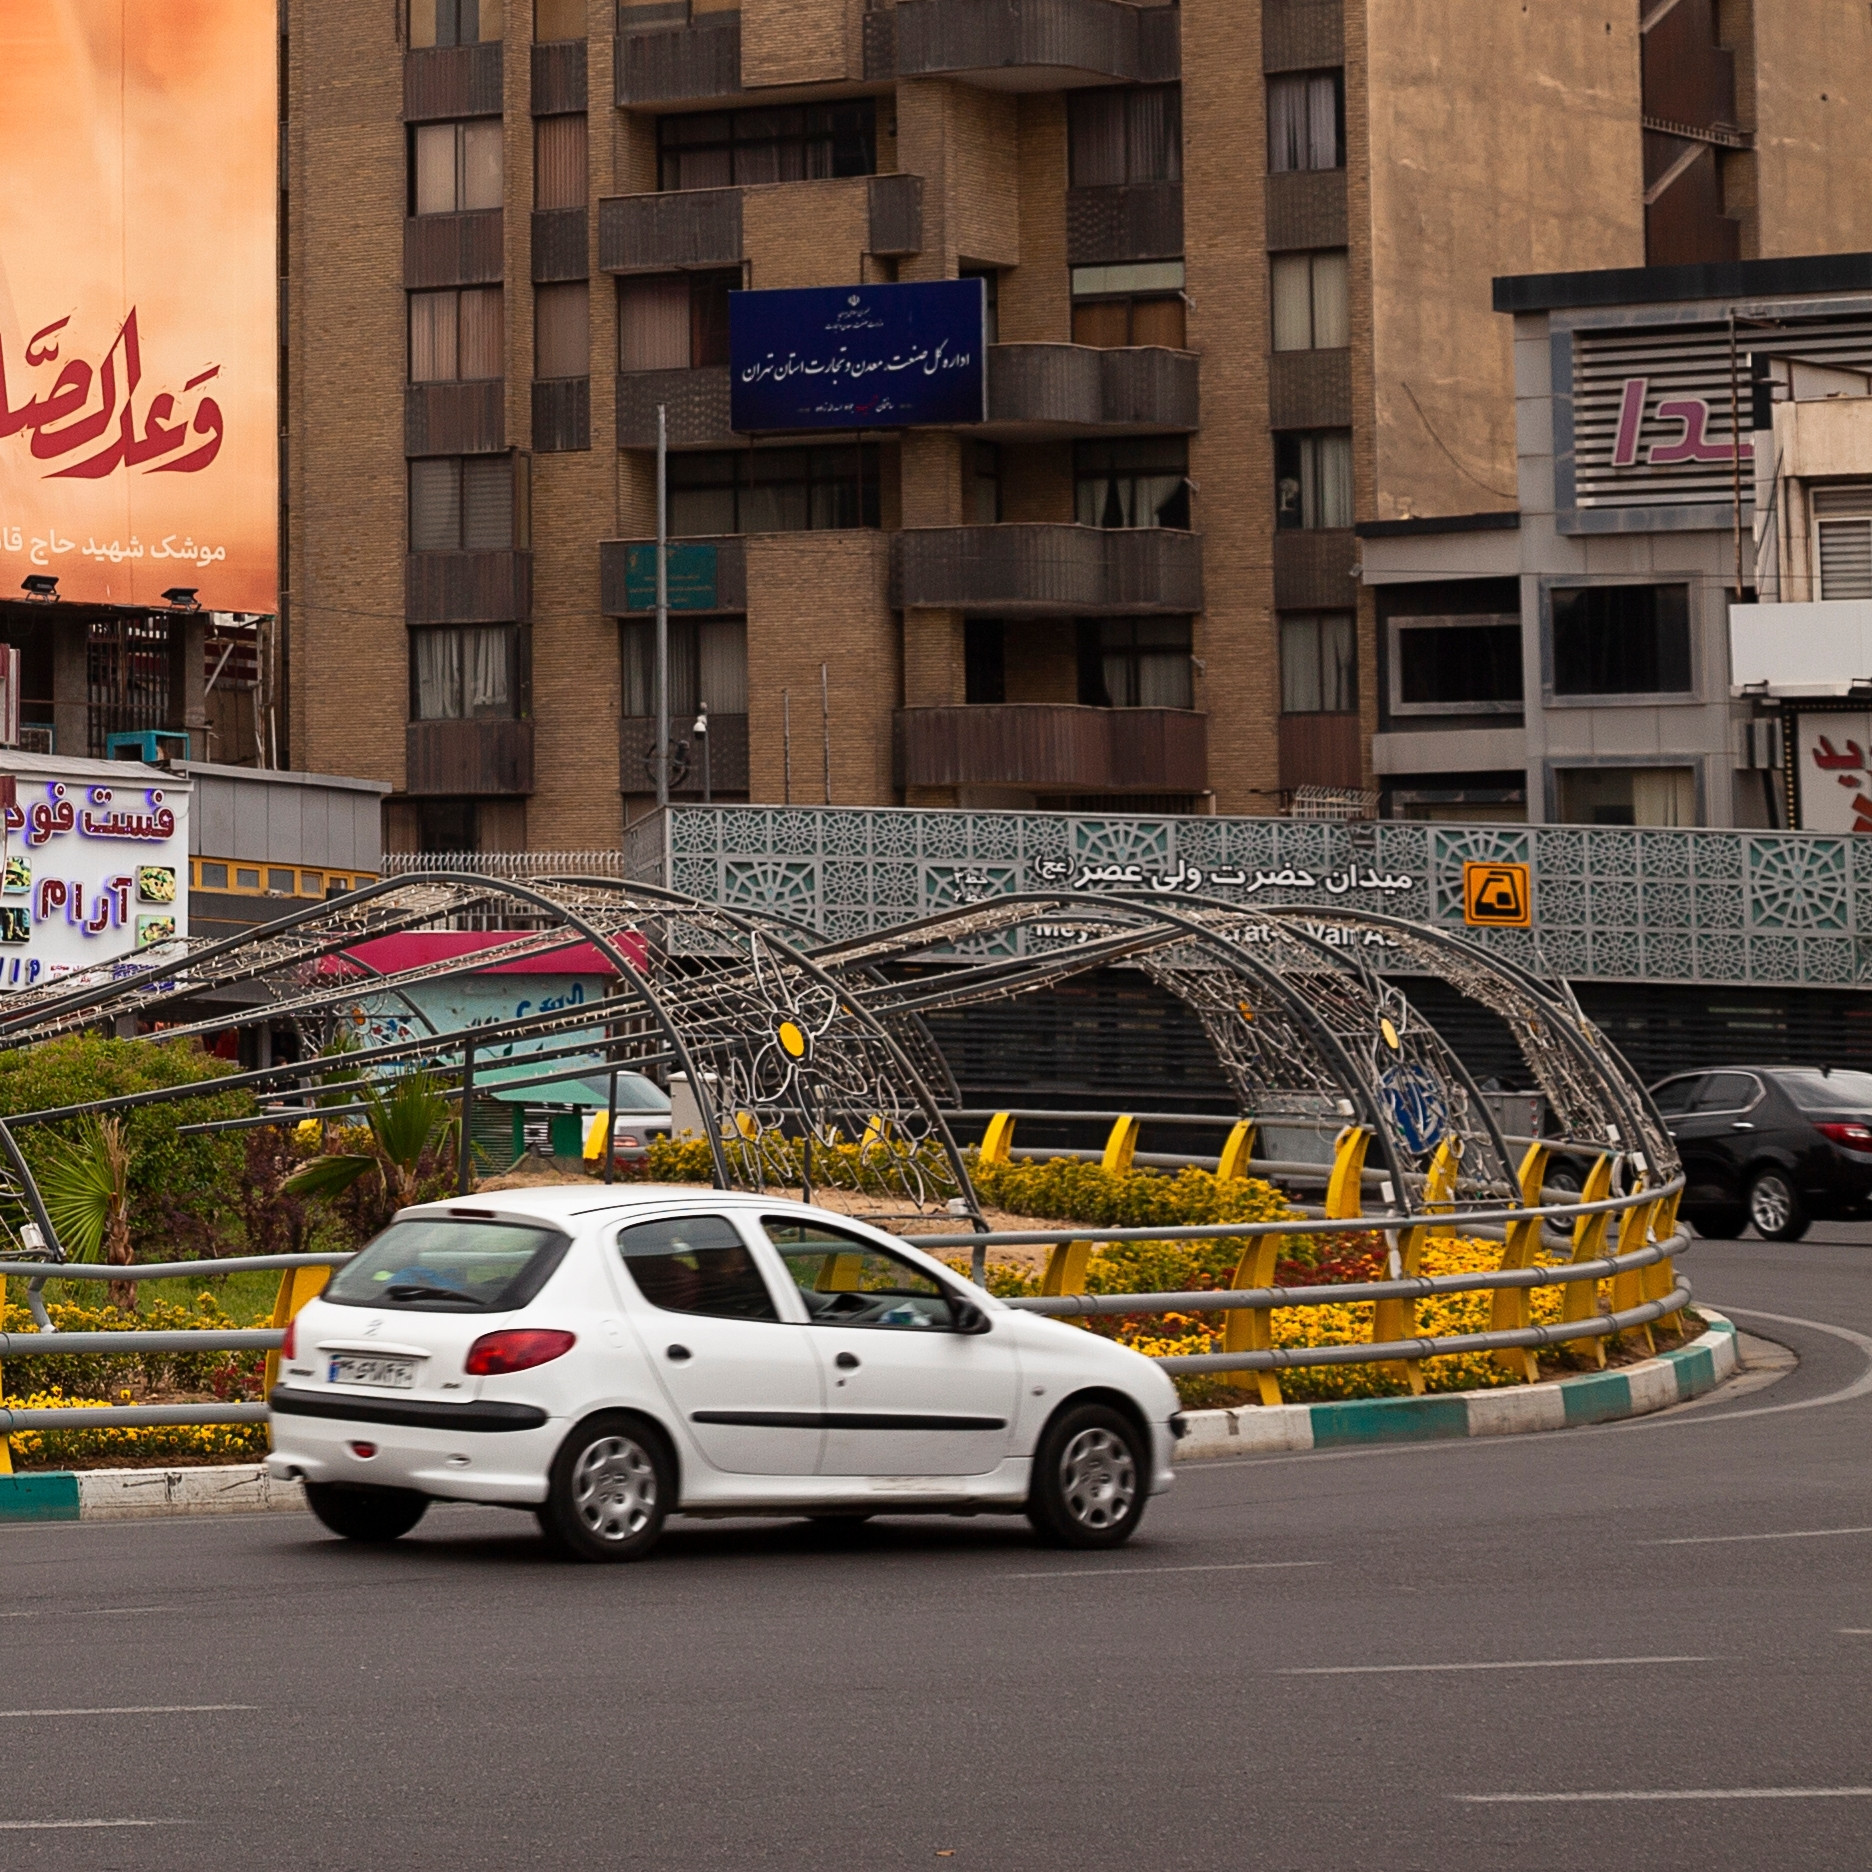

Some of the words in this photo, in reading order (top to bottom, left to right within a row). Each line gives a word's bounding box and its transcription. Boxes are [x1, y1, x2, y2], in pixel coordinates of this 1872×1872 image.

[30, 528, 76, 565] حاج
[81, 536, 144, 563] شهید
[150, 536, 226, 567] موشک
[7, 782, 76, 846] فود
[83, 787, 177, 841] فست
[1073, 862, 1143, 888] عصر
[1151, 858, 1203, 893] ولی
[1209, 860, 1317, 893] حضرت
[1326, 863, 1413, 894] میدان
[39, 875, 134, 935] آرام
